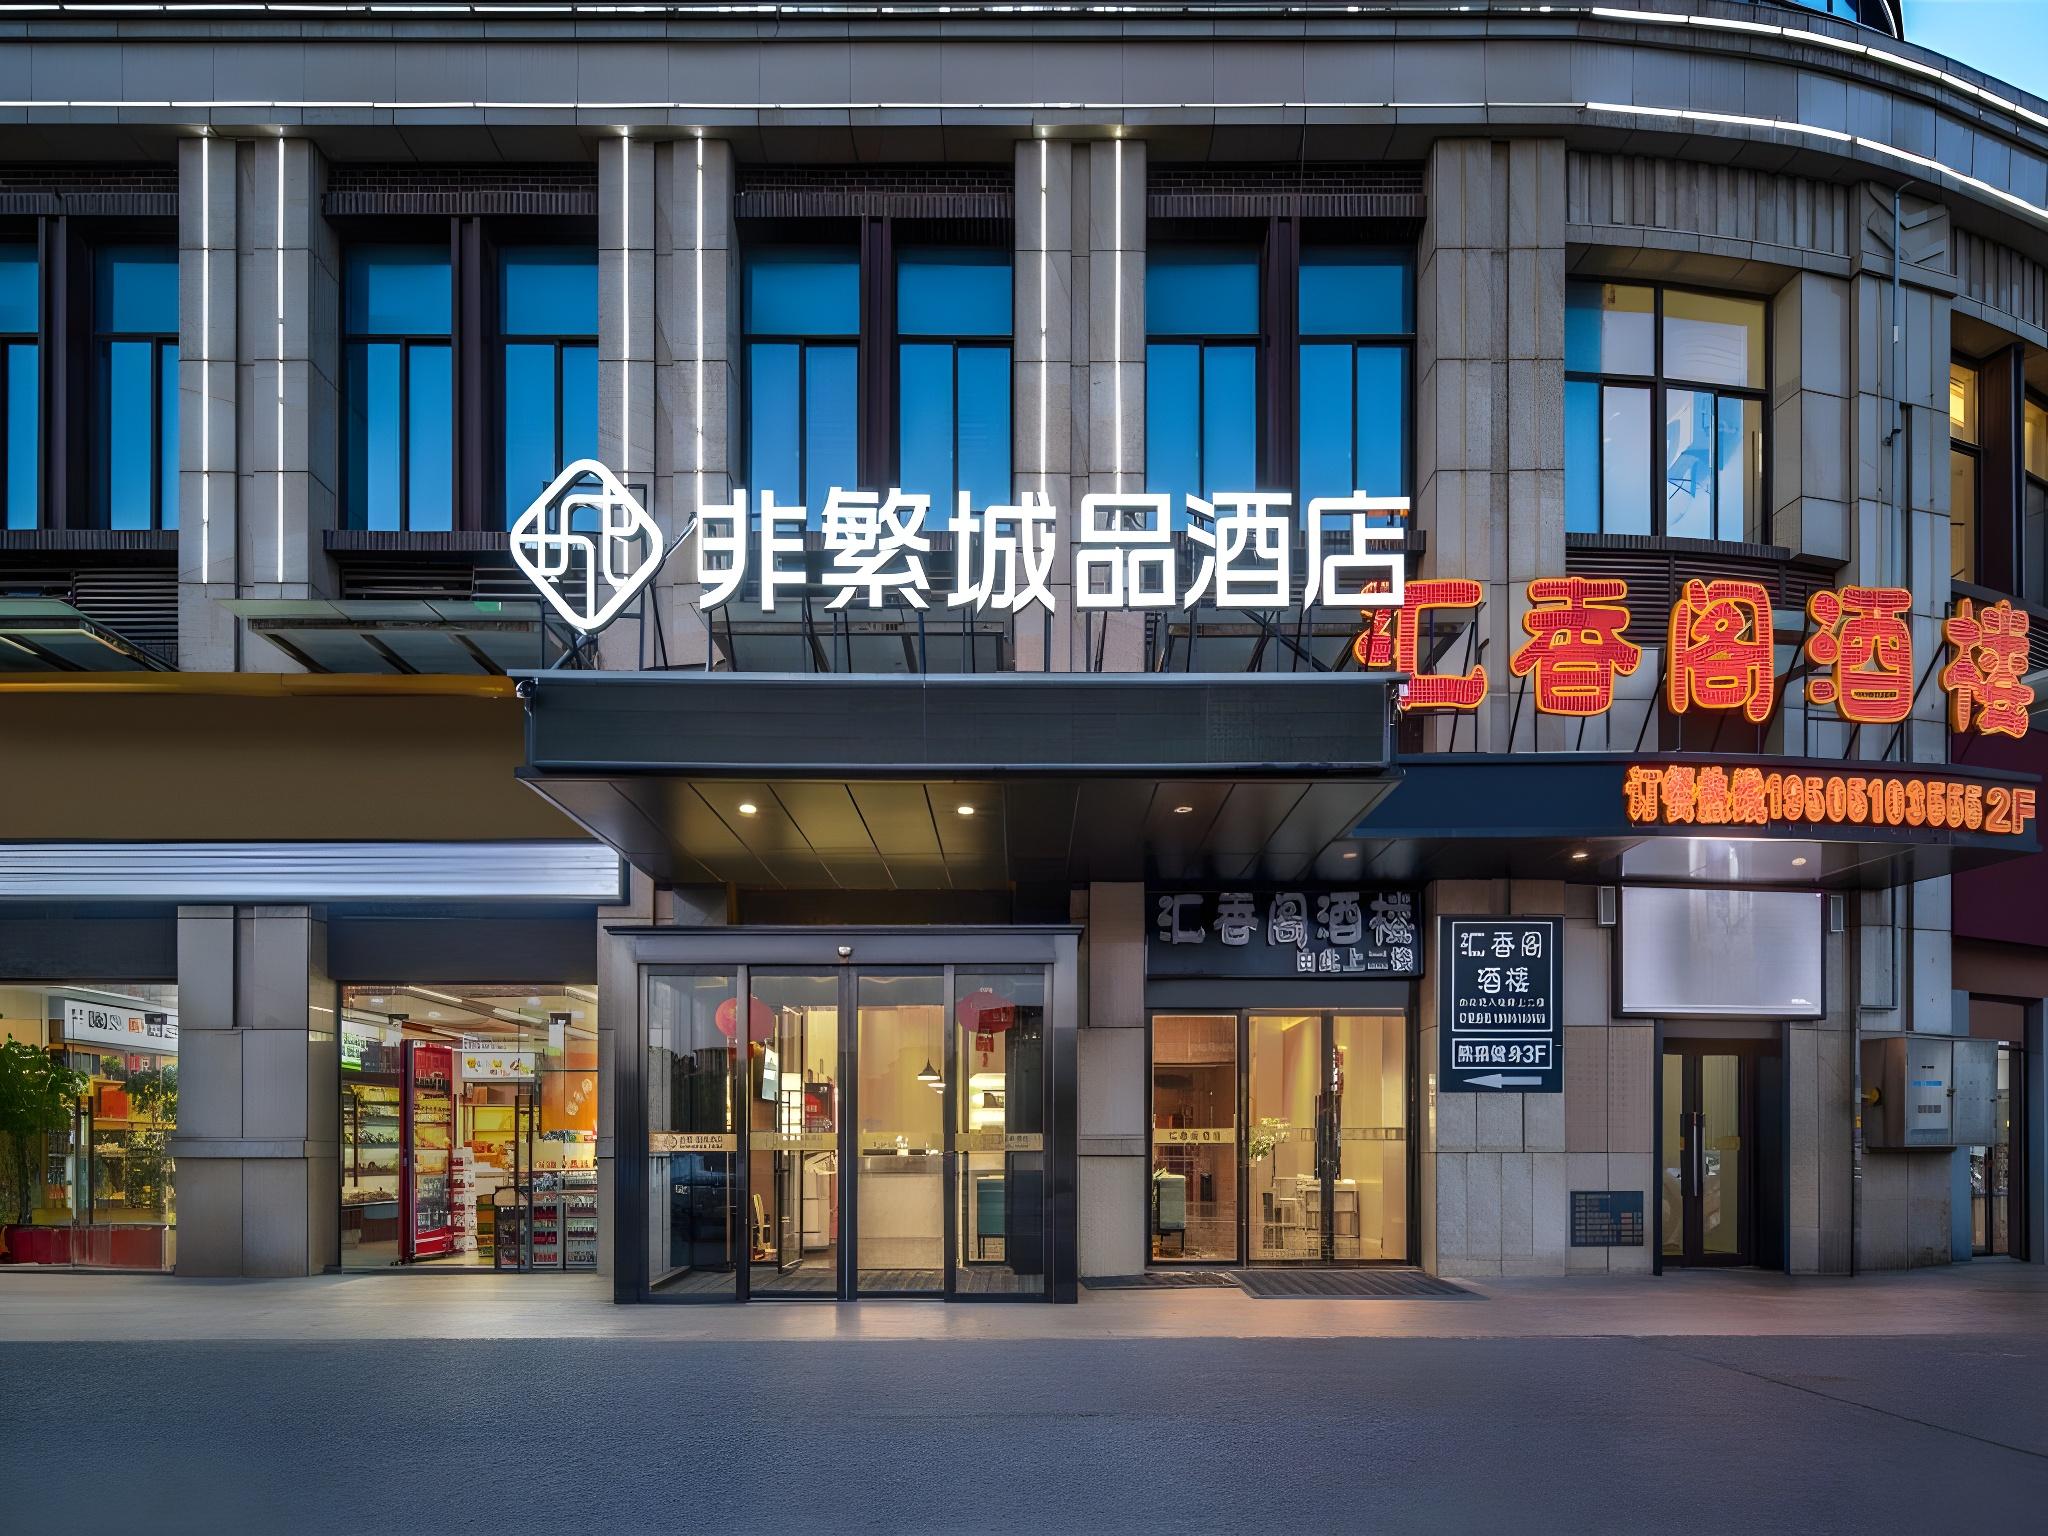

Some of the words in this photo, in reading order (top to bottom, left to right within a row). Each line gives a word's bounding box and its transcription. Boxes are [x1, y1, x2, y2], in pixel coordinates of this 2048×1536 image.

[698, 487, 1411, 613] 非繁城品酒店
[1460, 931, 1543, 959] 汇香阁
[1477, 967, 1530, 993] 酒楼
